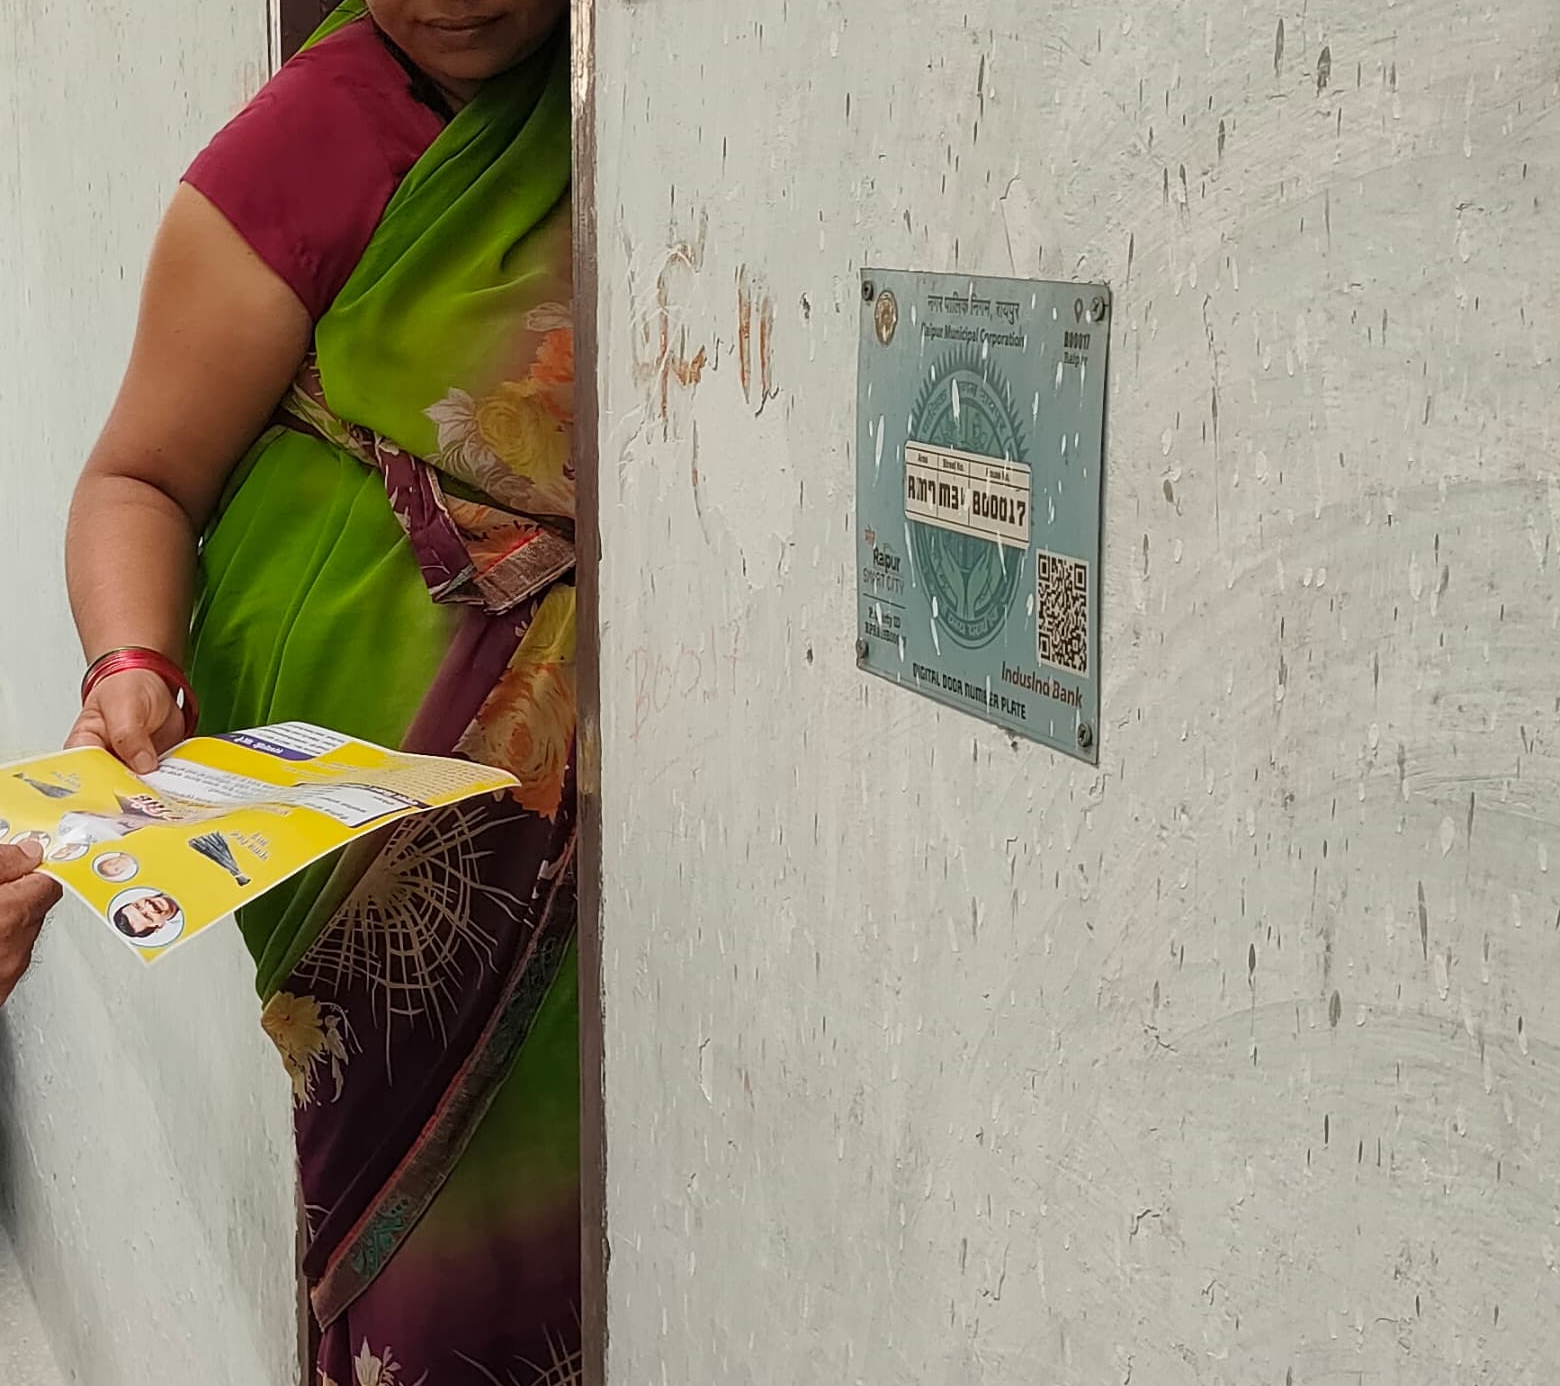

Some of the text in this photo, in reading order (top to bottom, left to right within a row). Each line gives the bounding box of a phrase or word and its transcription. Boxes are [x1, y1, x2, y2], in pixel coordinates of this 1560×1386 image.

[972, 490, 1025, 527] B00017
[912, 663, 940, 686] DIGITAL
[942, 675, 963, 695] DOOR
[1000, 697, 1027, 719] PLATE
[1051, 680, 1083, 709] Bank
